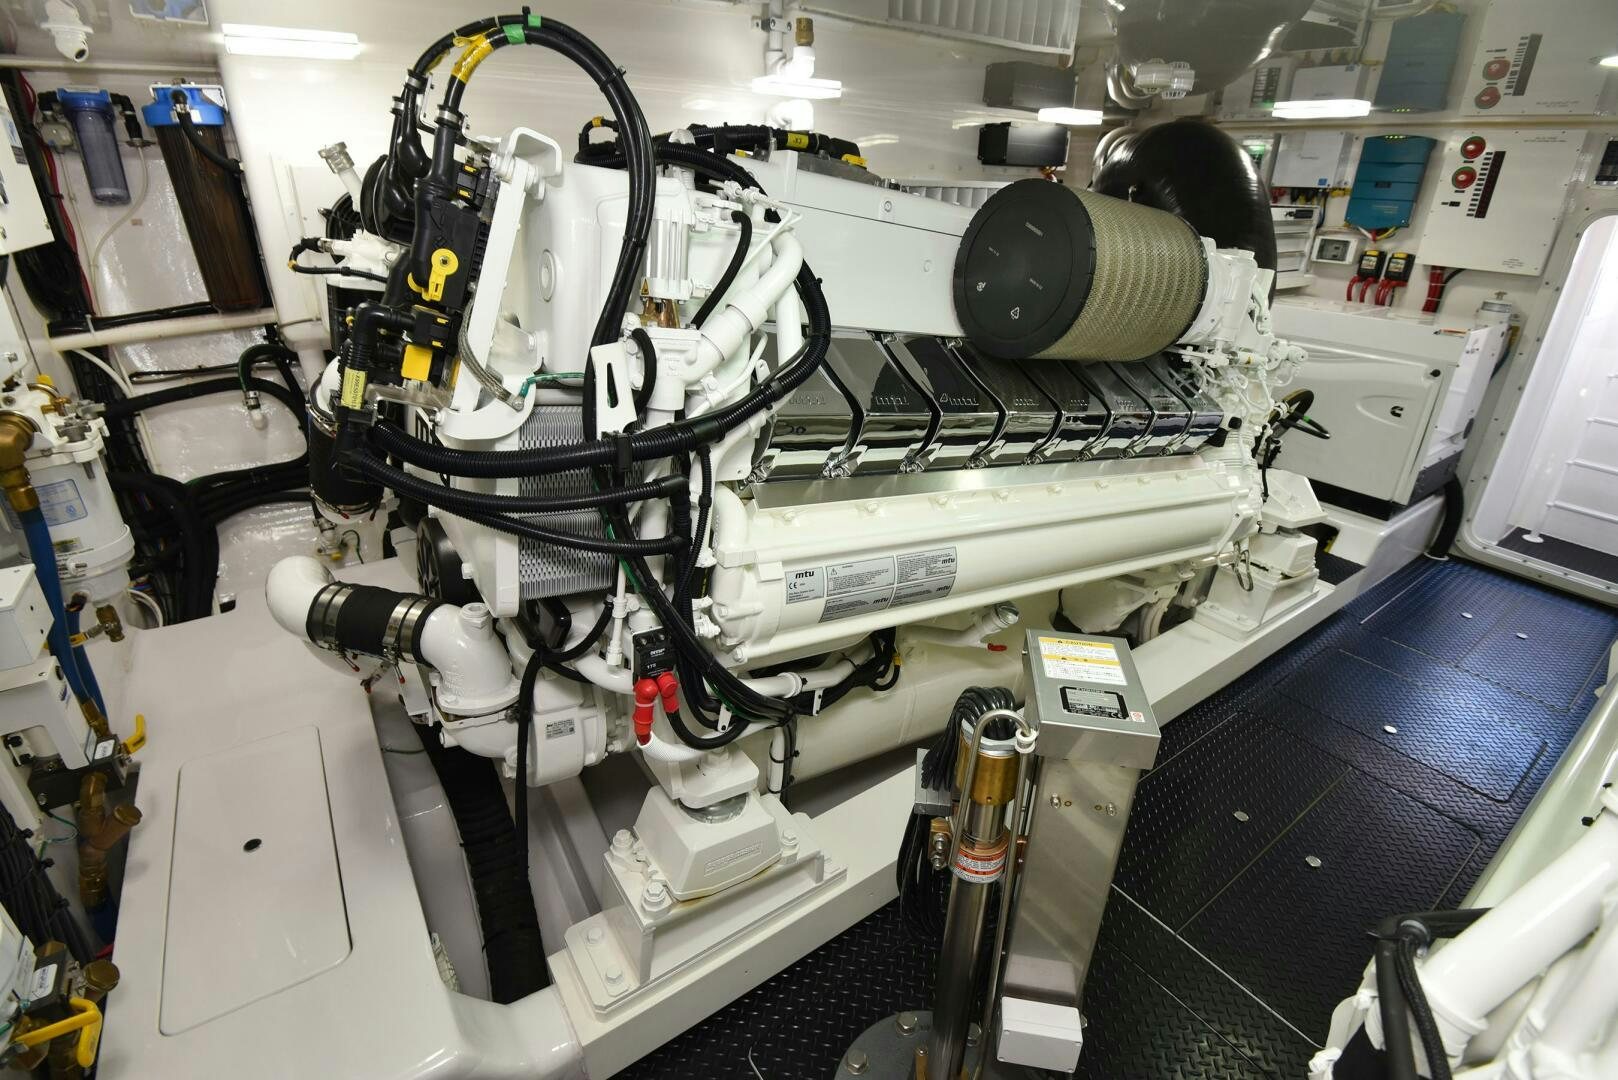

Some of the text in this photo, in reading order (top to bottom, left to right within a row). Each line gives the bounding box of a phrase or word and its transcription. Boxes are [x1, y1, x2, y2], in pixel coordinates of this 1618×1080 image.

[941, 557, 955, 565] mtu
[795, 570, 815, 579] mtu
[872, 596, 889, 604] mtu
